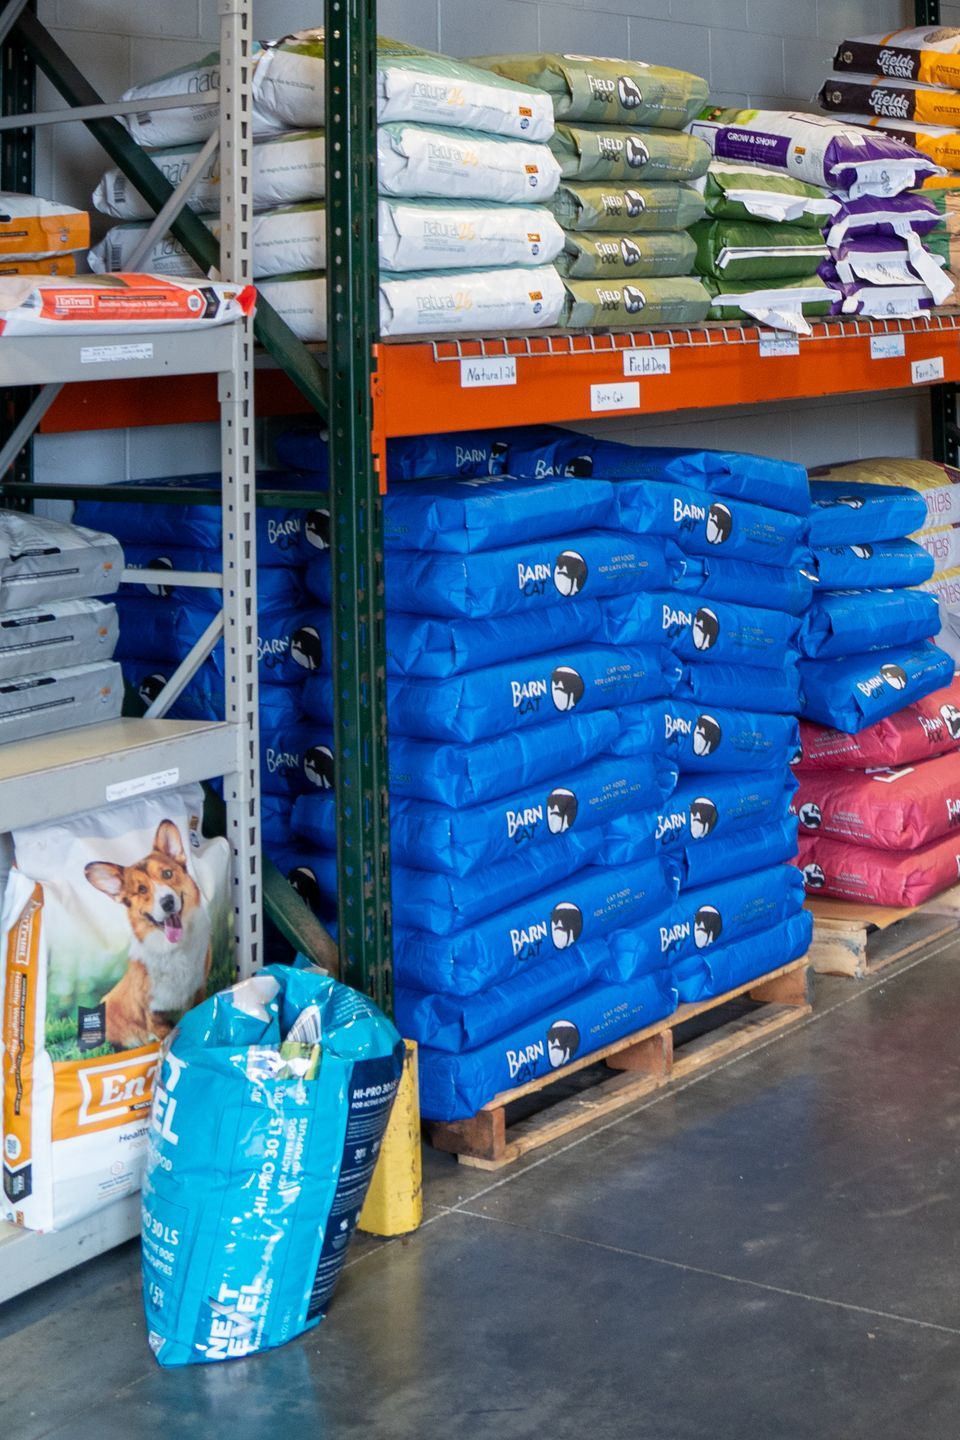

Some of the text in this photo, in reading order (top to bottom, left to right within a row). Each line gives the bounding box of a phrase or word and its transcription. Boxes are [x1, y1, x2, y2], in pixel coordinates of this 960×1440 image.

[877, 49, 915, 70] Fields
[882, 64, 913, 78] FARM
[587, 74, 615, 93] FIELD
[594, 91, 614, 103] DOG
[869, 89, 910, 109] Fields
[874, 105, 908, 119] FARM
[934, 105, 960, 114] POULTRY
[597, 135, 623, 153] FIELD
[727, 131, 749, 143] GROW
[755, 136, 778, 147] SHOW
[602, 150, 620, 162] DOG
[935, 147, 960, 157] POULTRY
[602, 193, 623, 211] FIELD
[606, 207, 622, 216] DOG
[595, 242, 619, 259] FIELD
[601, 254, 618, 264] DOG
[596, 288, 621, 305] FIELD
[602, 301, 619, 311] DOG
[467, 366, 503, 382] Natural
[629, 356, 667, 374] Field Dog
[455, 446, 487, 467] BARN
[673, 498, 705, 522] BARN
[518, 562, 551, 589] BARN
[523, 578, 548, 597] CAT
[662, 605, 692, 629] BARN
[511, 680, 547, 708] BARN
[857, 675, 884, 698] BARN
[871, 687, 885, 700] CAT
[519, 697, 542, 715] CAT
[664, 714, 692, 739] BARN
[918, 713, 943, 736] FARM
[267, 748, 299, 773] BARN
[506, 805, 543, 839] BARN
[655, 812, 686, 840] BARN
[514, 824, 536, 844] CAT
[510, 922, 547, 957] BARN
[660, 921, 690, 953] BARN
[518, 942, 542, 960] CAT
[506, 1040, 544, 1078] BARN
[516, 1062, 538, 1083] CAT
[353, 1085, 382, 1100] HI-PRO
[287, 1118, 298, 1141] DOG
[252, 1116, 284, 1217] HI-PRO 30 LS
[281, 1141, 295, 1173] ACTIVE
[152, 1217, 164, 1239] 30
[164, 1226, 180, 1246] LS
[159, 1246, 176, 1263] DOG
[205, 1282, 240, 1360] NEXT
[226, 1276, 265, 1356] EVEL
